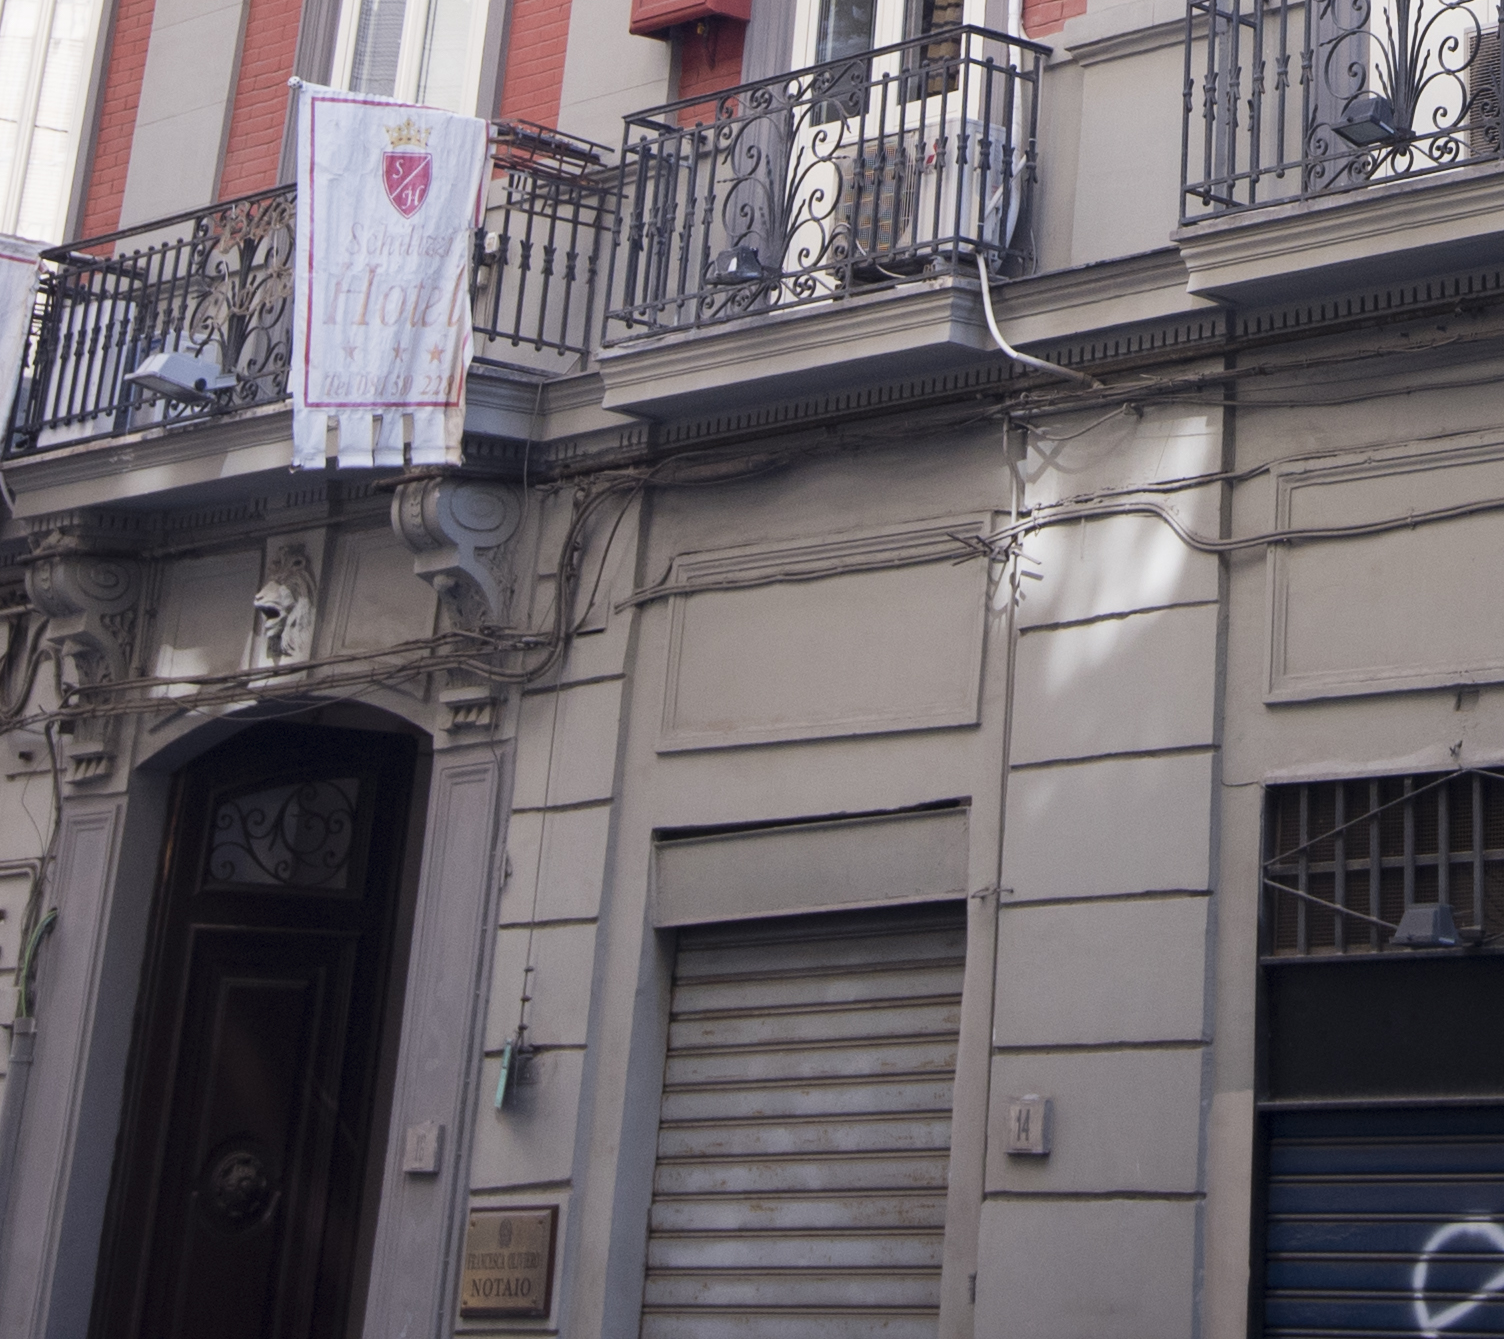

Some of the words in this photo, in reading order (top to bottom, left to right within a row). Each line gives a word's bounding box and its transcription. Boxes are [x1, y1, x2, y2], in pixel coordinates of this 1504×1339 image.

[392, 159, 404, 179] S
[323, 262, 466, 327] Hotel
[1017, 1109, 1030, 1141] 14
[471, 1277, 532, 1297] NOTAIO
